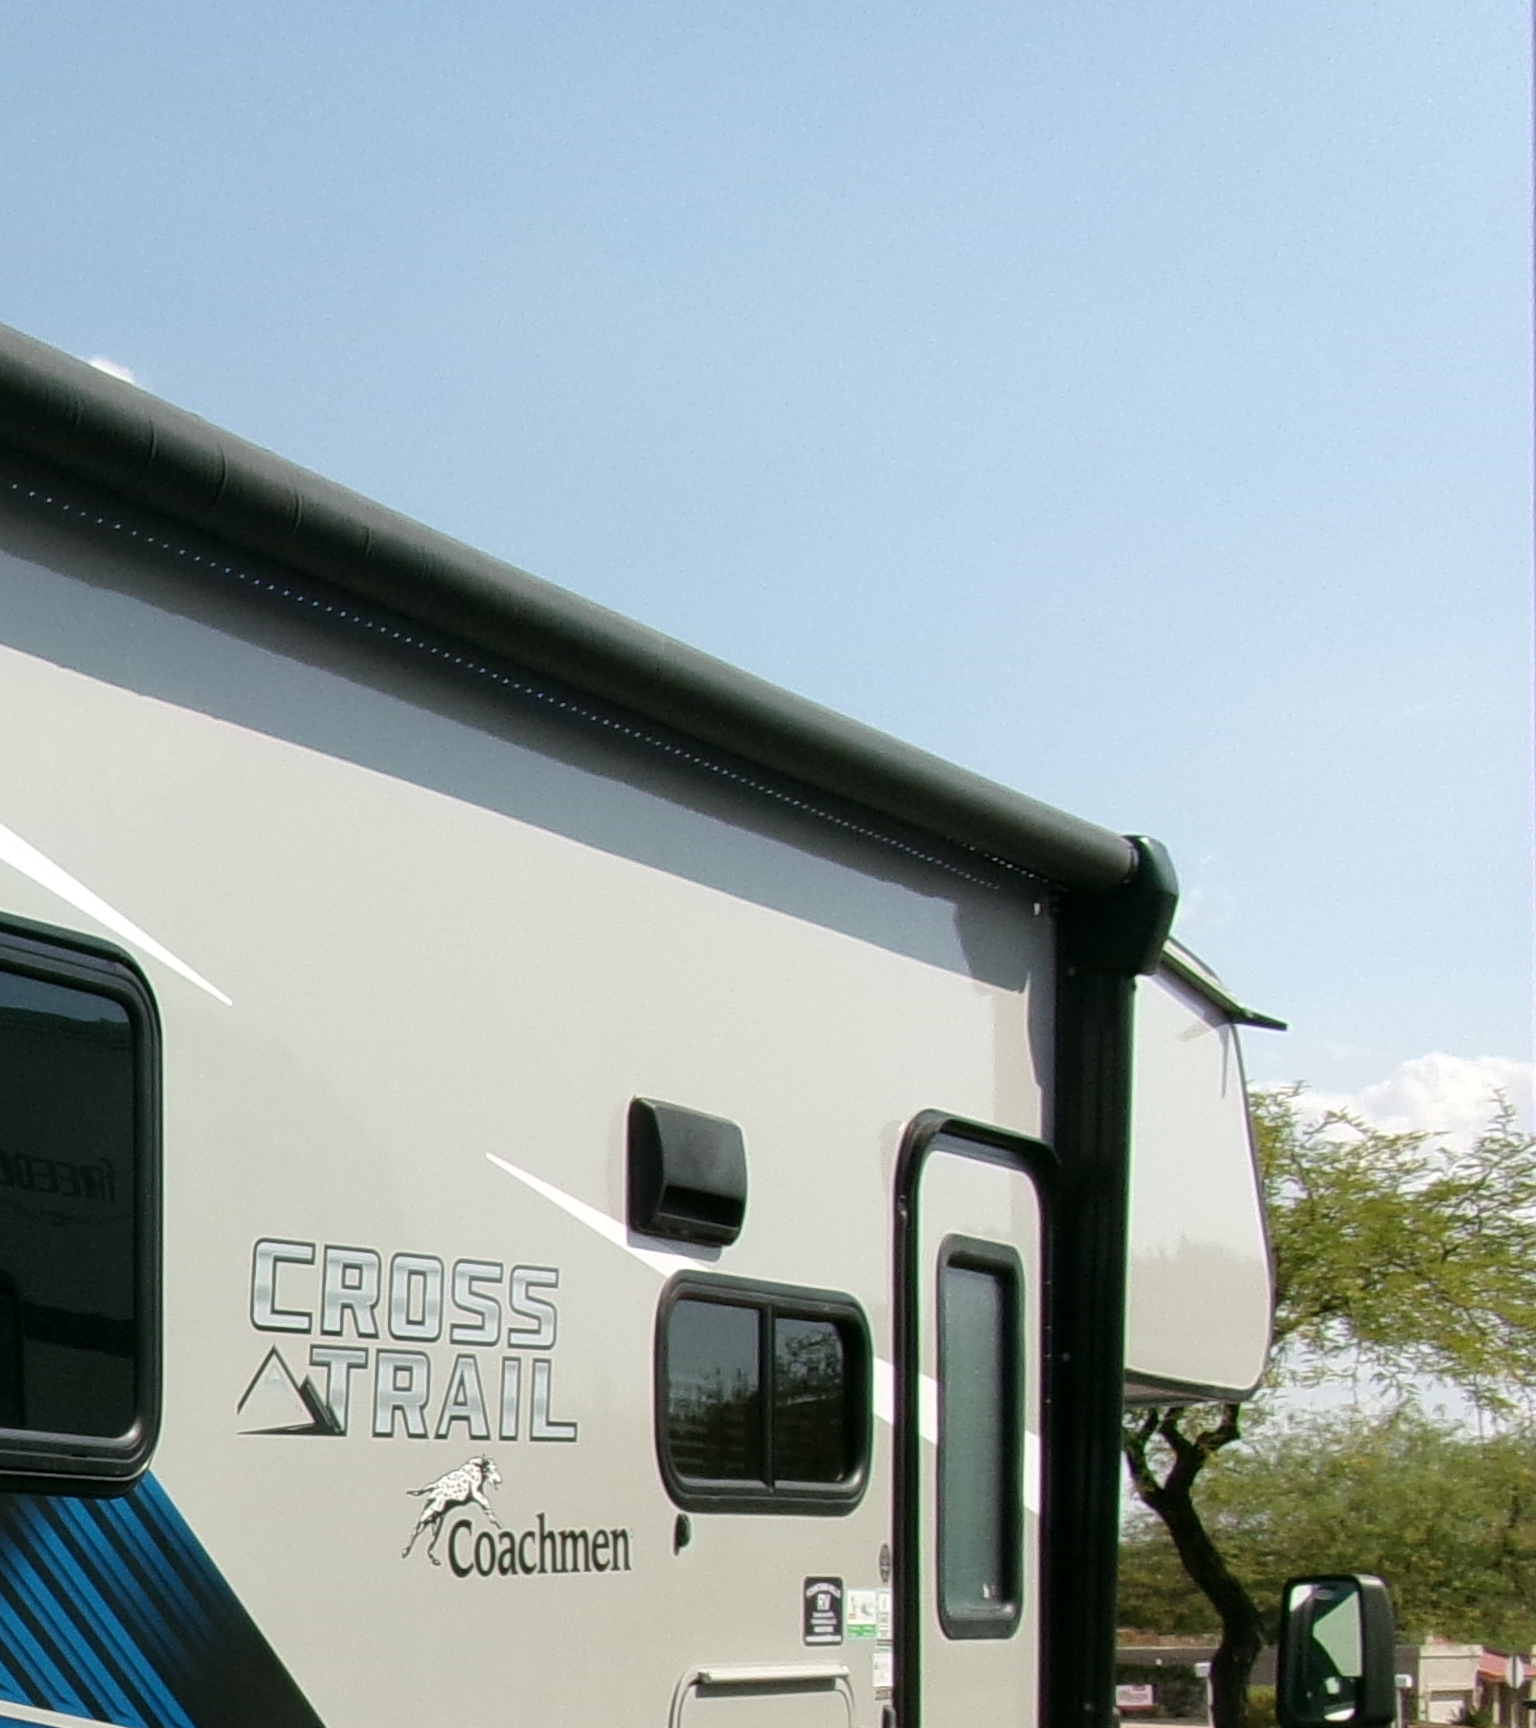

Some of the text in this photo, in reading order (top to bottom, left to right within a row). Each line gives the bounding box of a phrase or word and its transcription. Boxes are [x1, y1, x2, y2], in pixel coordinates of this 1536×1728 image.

[249, 1236, 560, 1351] CROSS
[308, 1343, 579, 1443] TRAIL
[448, 1513, 632, 1579] Coachmen
